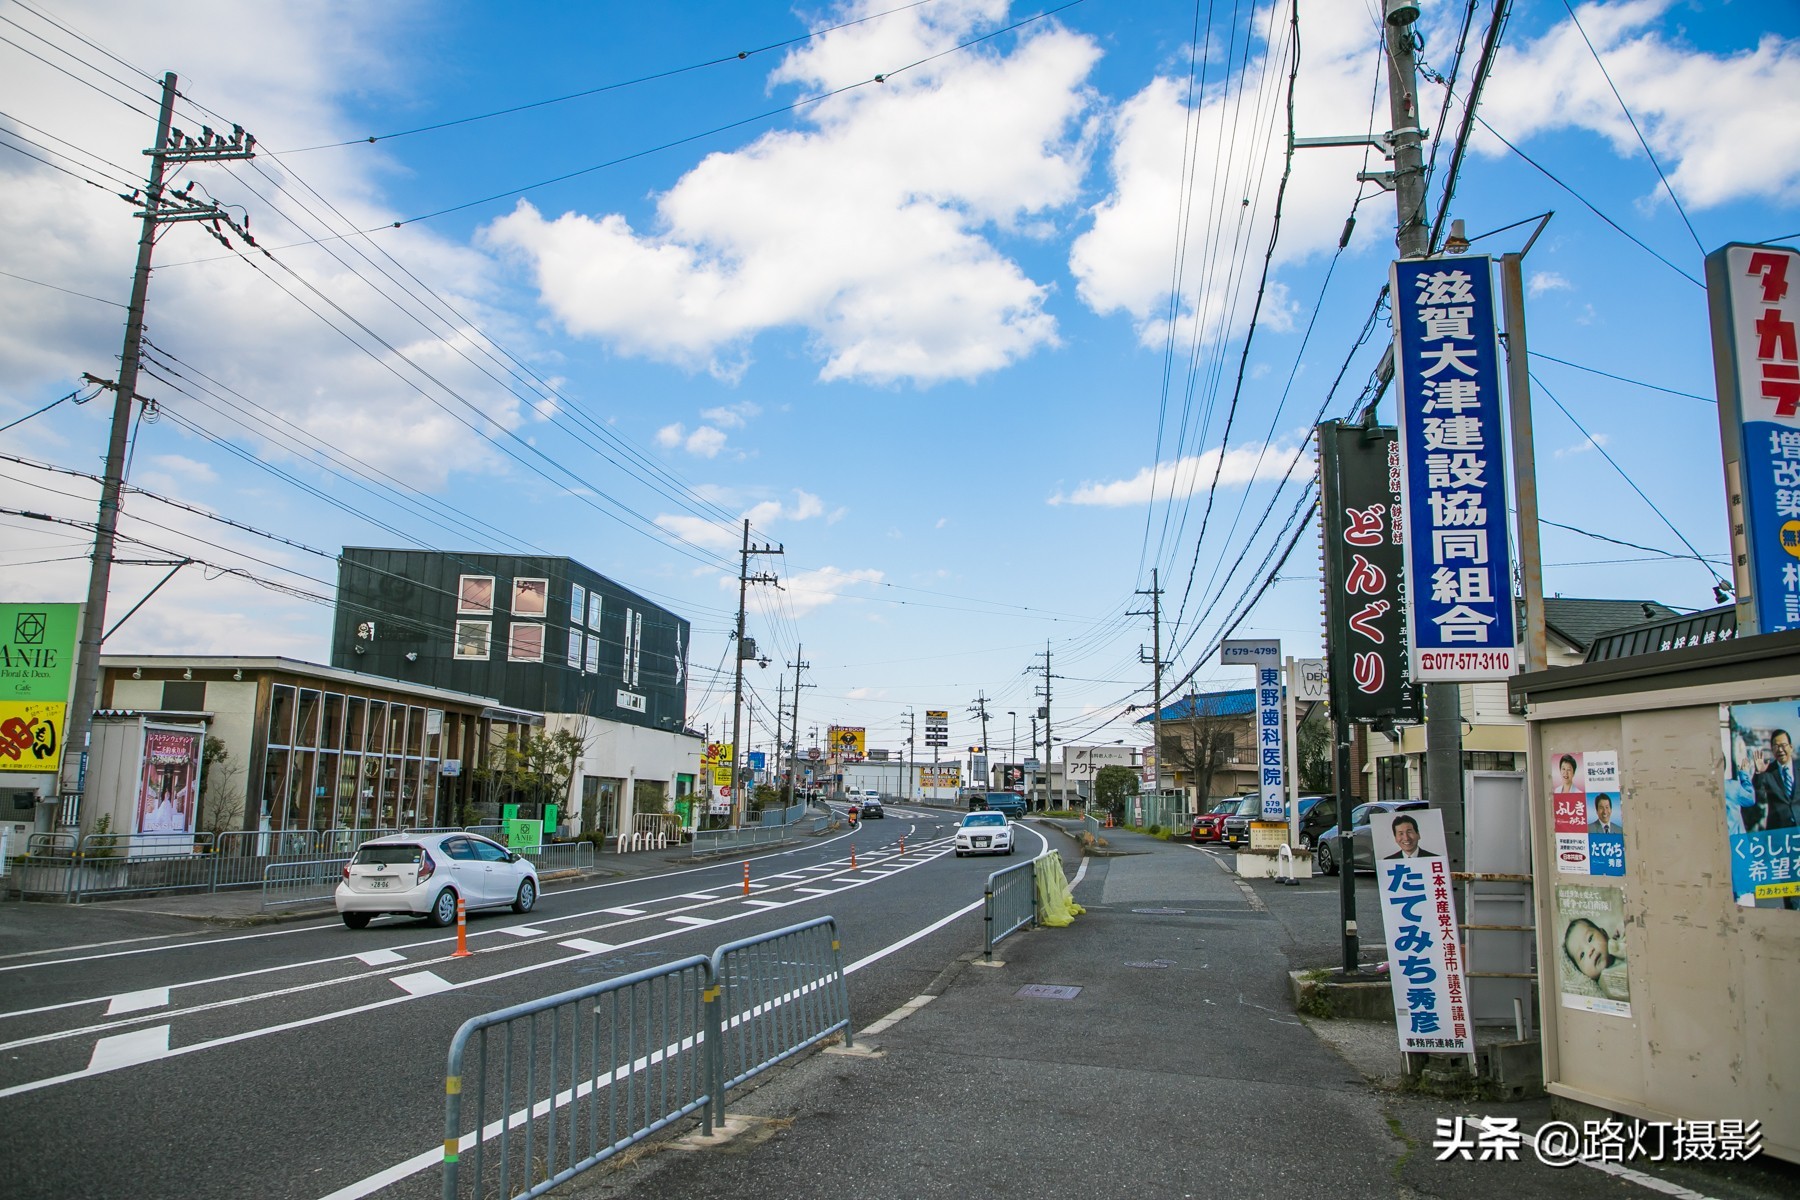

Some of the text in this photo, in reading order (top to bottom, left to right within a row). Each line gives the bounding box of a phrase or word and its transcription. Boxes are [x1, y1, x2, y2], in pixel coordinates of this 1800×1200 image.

[1745, 252, 1800, 417] タカラ
[1415, 270, 1495, 643] 滋賀大津建設協同組合
[1782, 529, 1800, 547] 無
[1344, 504, 1390, 694] どんぐり
[0, 644, 57, 668] ANIE
[1232, 647, 1278, 656] 579-4799
[1436, 653, 1509, 670] 077-577-3110
[1, 670, 20, 678] Floral
[22, 670, 29, 678] &
[15, 684, 31, 692] Cafe
[1260, 668, 1282, 786] 東野歯科医院
[1556, 801, 1585, 816] ふしき
[1592, 841, 1623, 857] たてみち
[1735, 834, 1800, 859] くらしに
[1387, 864, 1441, 1034] たてみち秀彦
[1431, 861, 1468, 1039] 日本共産党大津市議会議員
[1406, 1037, 1465, 1050] 事務所連絡所
